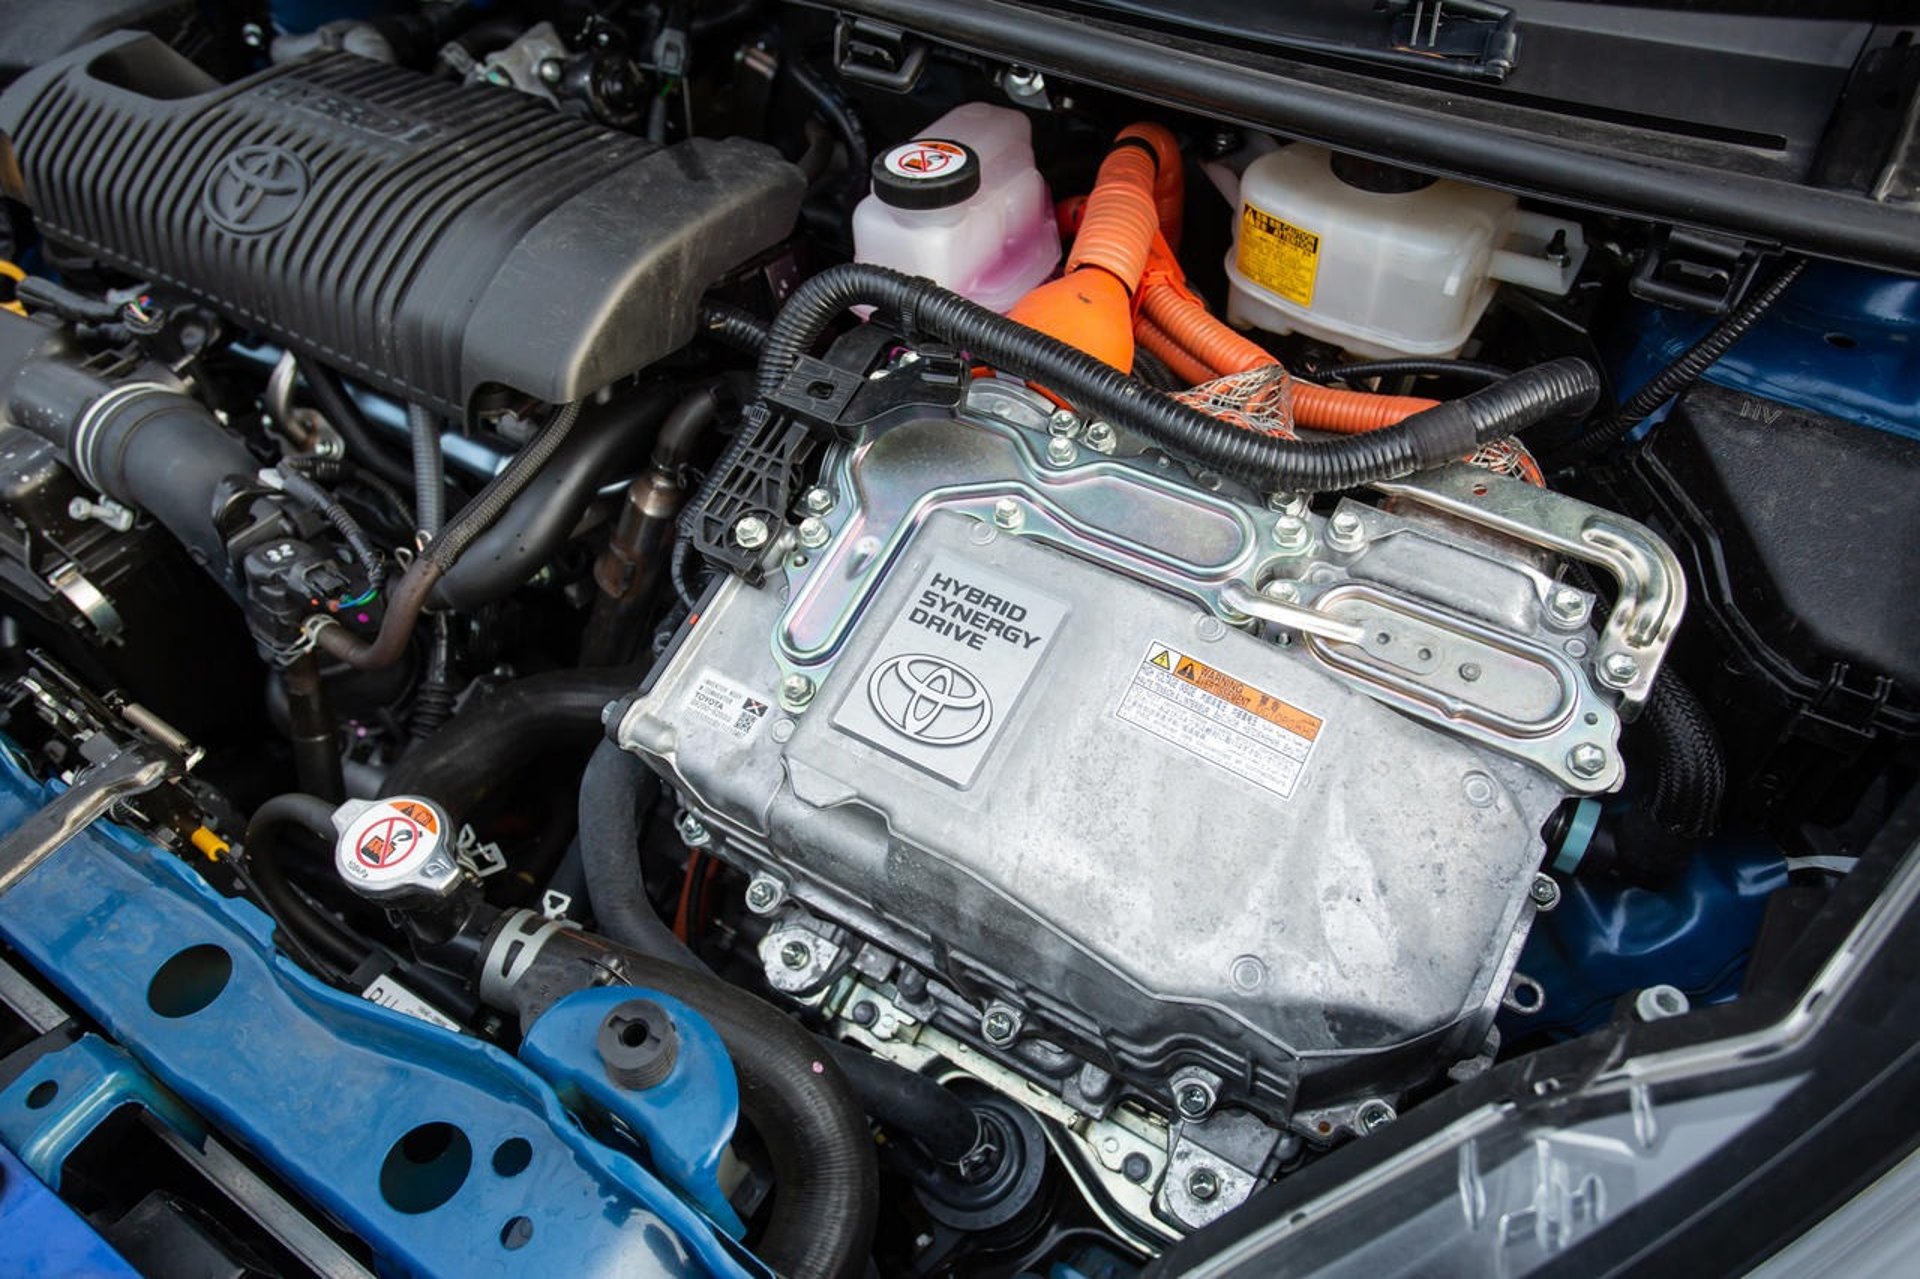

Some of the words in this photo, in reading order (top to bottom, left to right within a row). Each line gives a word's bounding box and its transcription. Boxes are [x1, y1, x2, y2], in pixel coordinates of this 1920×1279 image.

[919, 590, 1042, 649] SYNERGY
[930, 573, 1027, 623] HYBRID
[908, 607, 987, 651] DRIVE
[695, 690, 723, 710] TOYOTA
[1200, 666, 1245, 695] WARNING
